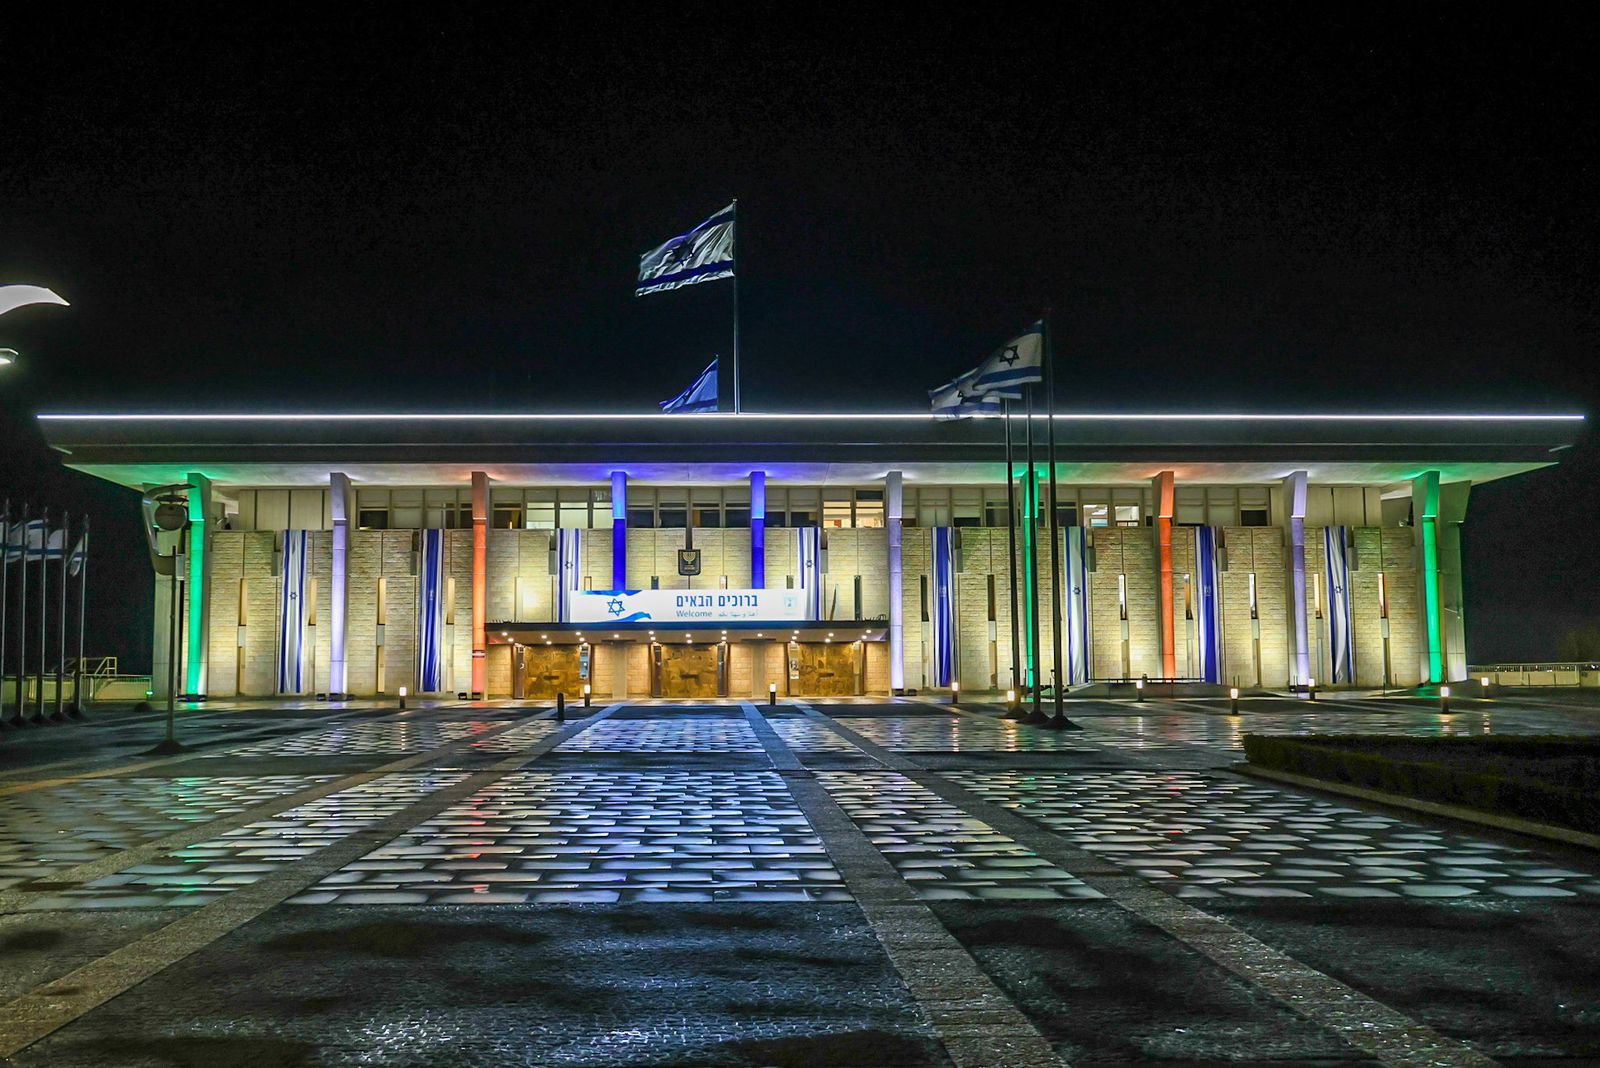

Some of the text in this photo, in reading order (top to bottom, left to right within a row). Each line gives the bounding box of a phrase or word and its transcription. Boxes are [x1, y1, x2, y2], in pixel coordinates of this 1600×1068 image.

[676, 595, 758, 607] ברוכים הבאים
[676, 610, 713, 618] Welcome
